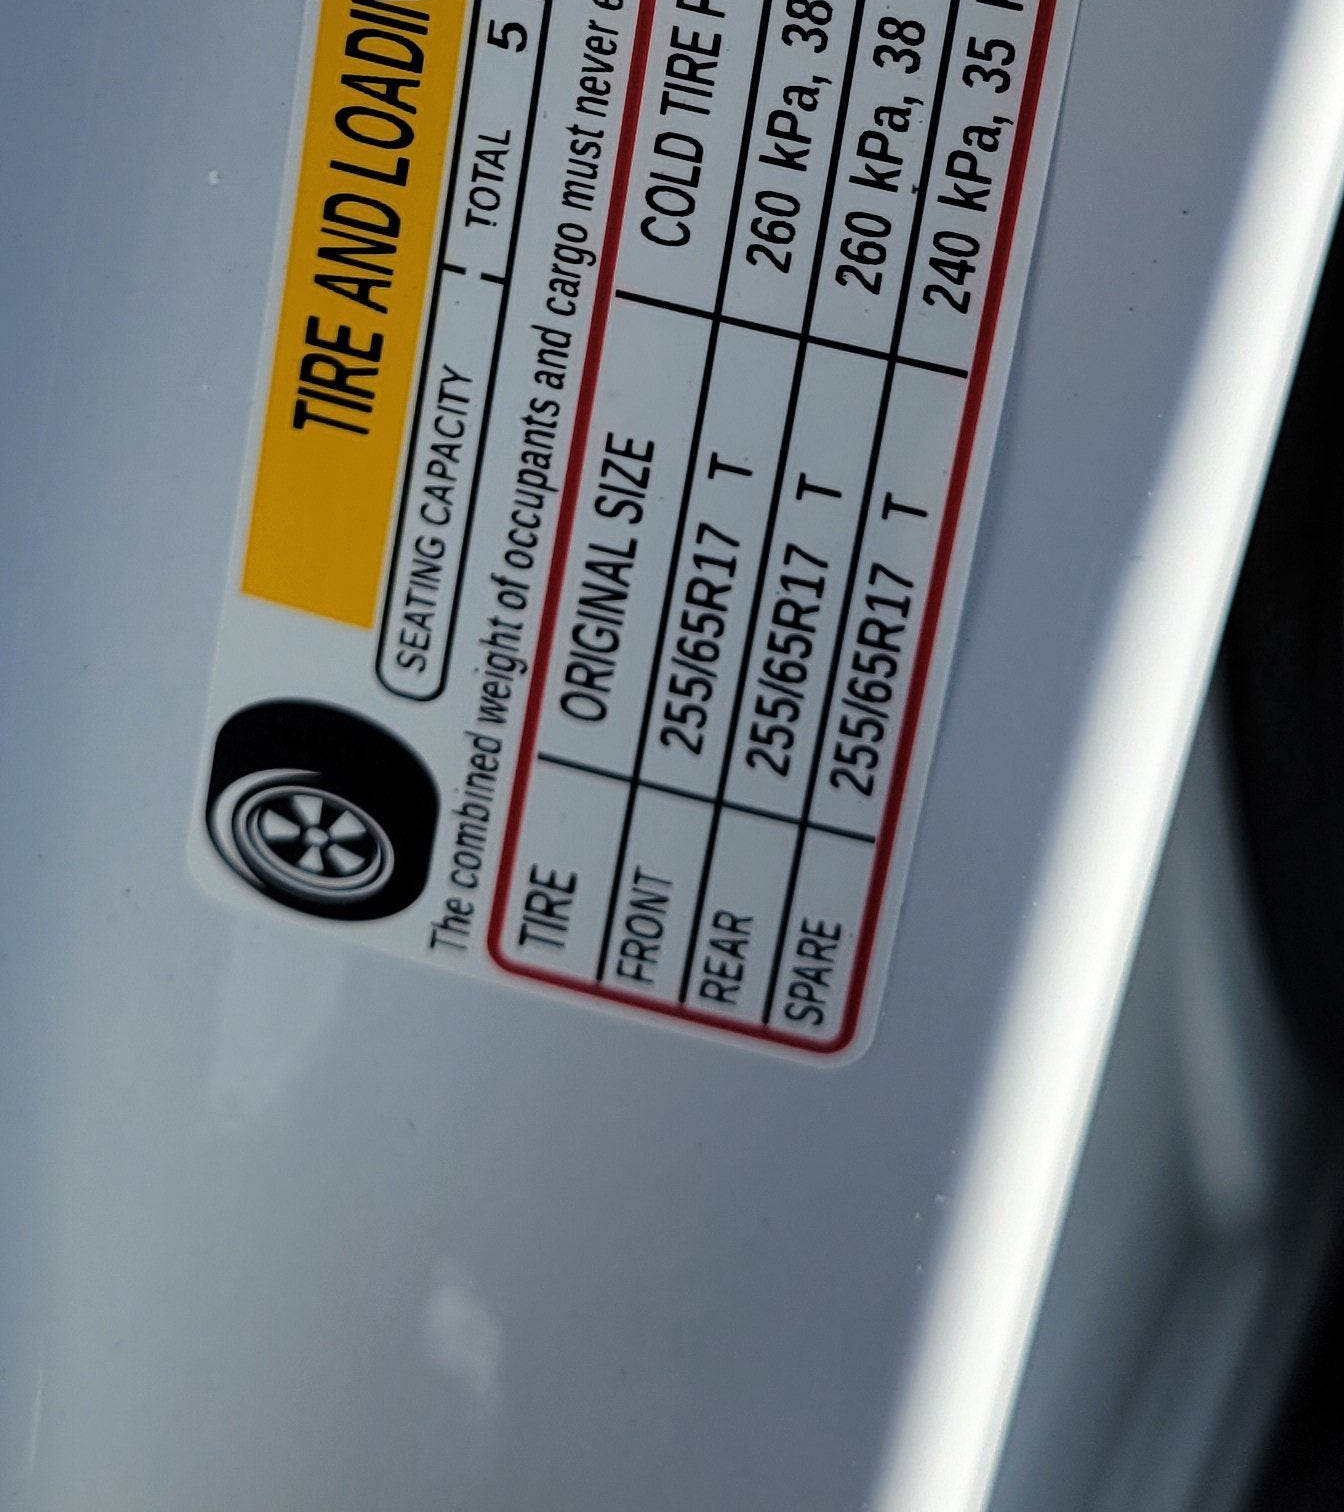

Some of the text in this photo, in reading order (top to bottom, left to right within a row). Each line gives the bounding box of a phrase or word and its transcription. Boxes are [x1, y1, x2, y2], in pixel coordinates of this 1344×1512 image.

[575, 19, 619, 118] never
[659, 25, 722, 116] TIRE
[872, 16, 926, 75] 38
[961, 36, 1016, 94] 35
[464, 19, 528, 228] TOTAL 5
[561, 123, 605, 212] must
[758, 75, 833, 172] kPa,
[848, 96, 924, 193] kPa,
[937, 115, 1014, 213] kPa,
[640, 131, 704, 247] COLD
[745, 190, 801, 274] 260
[313, 193, 401, 315] AND
[546, 222, 597, 317] cargo
[835, 211, 892, 295] 260
[922, 230, 981, 315] 240
[292, 315, 384, 435] TIRE
[530, 324, 572, 390] and
[396, 364, 472, 674] SEATING CAPACITY
[504, 397, 561, 570] occupants
[490, 573, 530, 611] of
[559, 431, 655, 722] ORIGINAL SIZE
[659, 451, 753, 756] 255/65R17 T
[745, 472, 842, 777] 255/65R17 T
[477, 616, 529, 725] weight
[829, 491, 928, 797] 255/65R17 T
[450, 731, 502, 890] combined
[429, 898, 475, 949] The
[518, 865, 577, 947] TIRE
[616, 866, 672, 983] FRONT
[698, 910, 753, 1005] REAR
[784, 918, 842, 1027] SPARE
